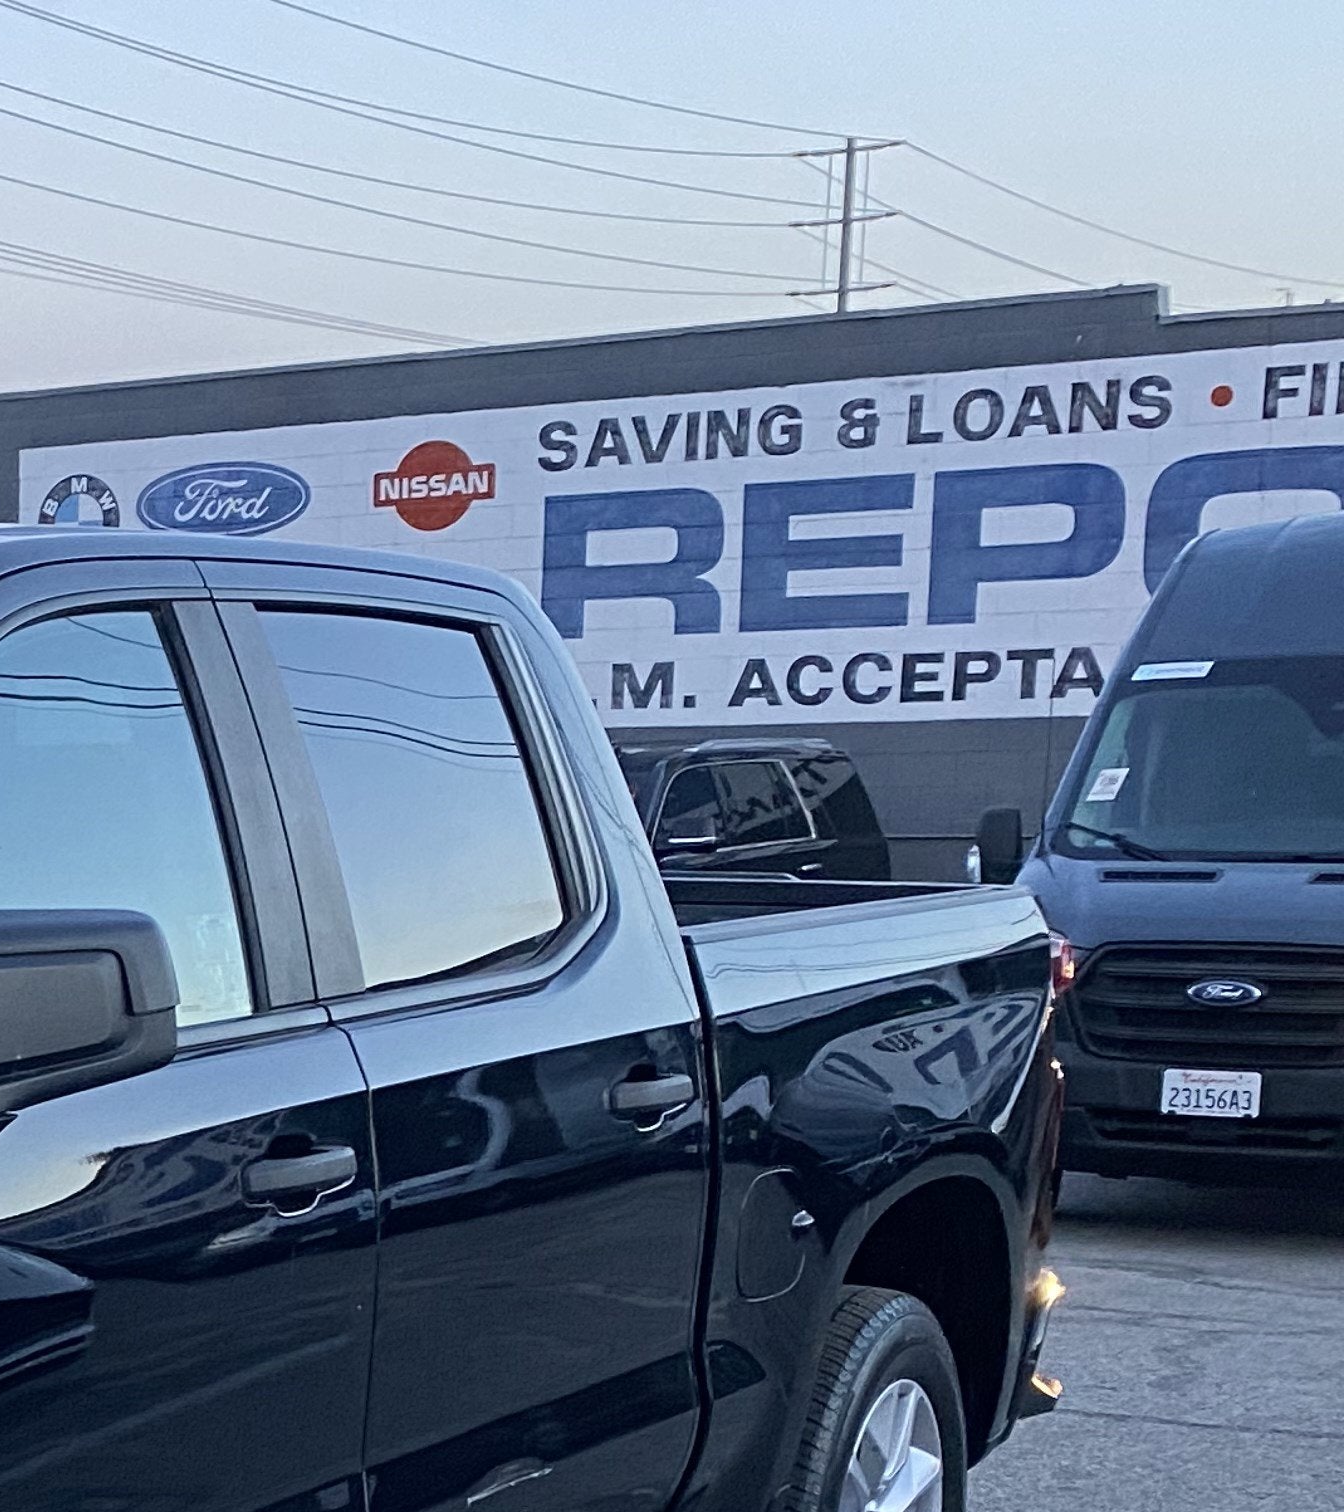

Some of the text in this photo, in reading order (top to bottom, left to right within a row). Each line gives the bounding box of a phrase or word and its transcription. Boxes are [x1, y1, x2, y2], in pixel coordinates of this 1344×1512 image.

[537, 360, 1344, 472] SAVING & LOANS FI
[41, 474, 118, 515] BMW
[174, 478, 272, 522] Ford
[378, 470, 490, 501] NISSAN
[1168, 1086, 1253, 1111] 23156A3
